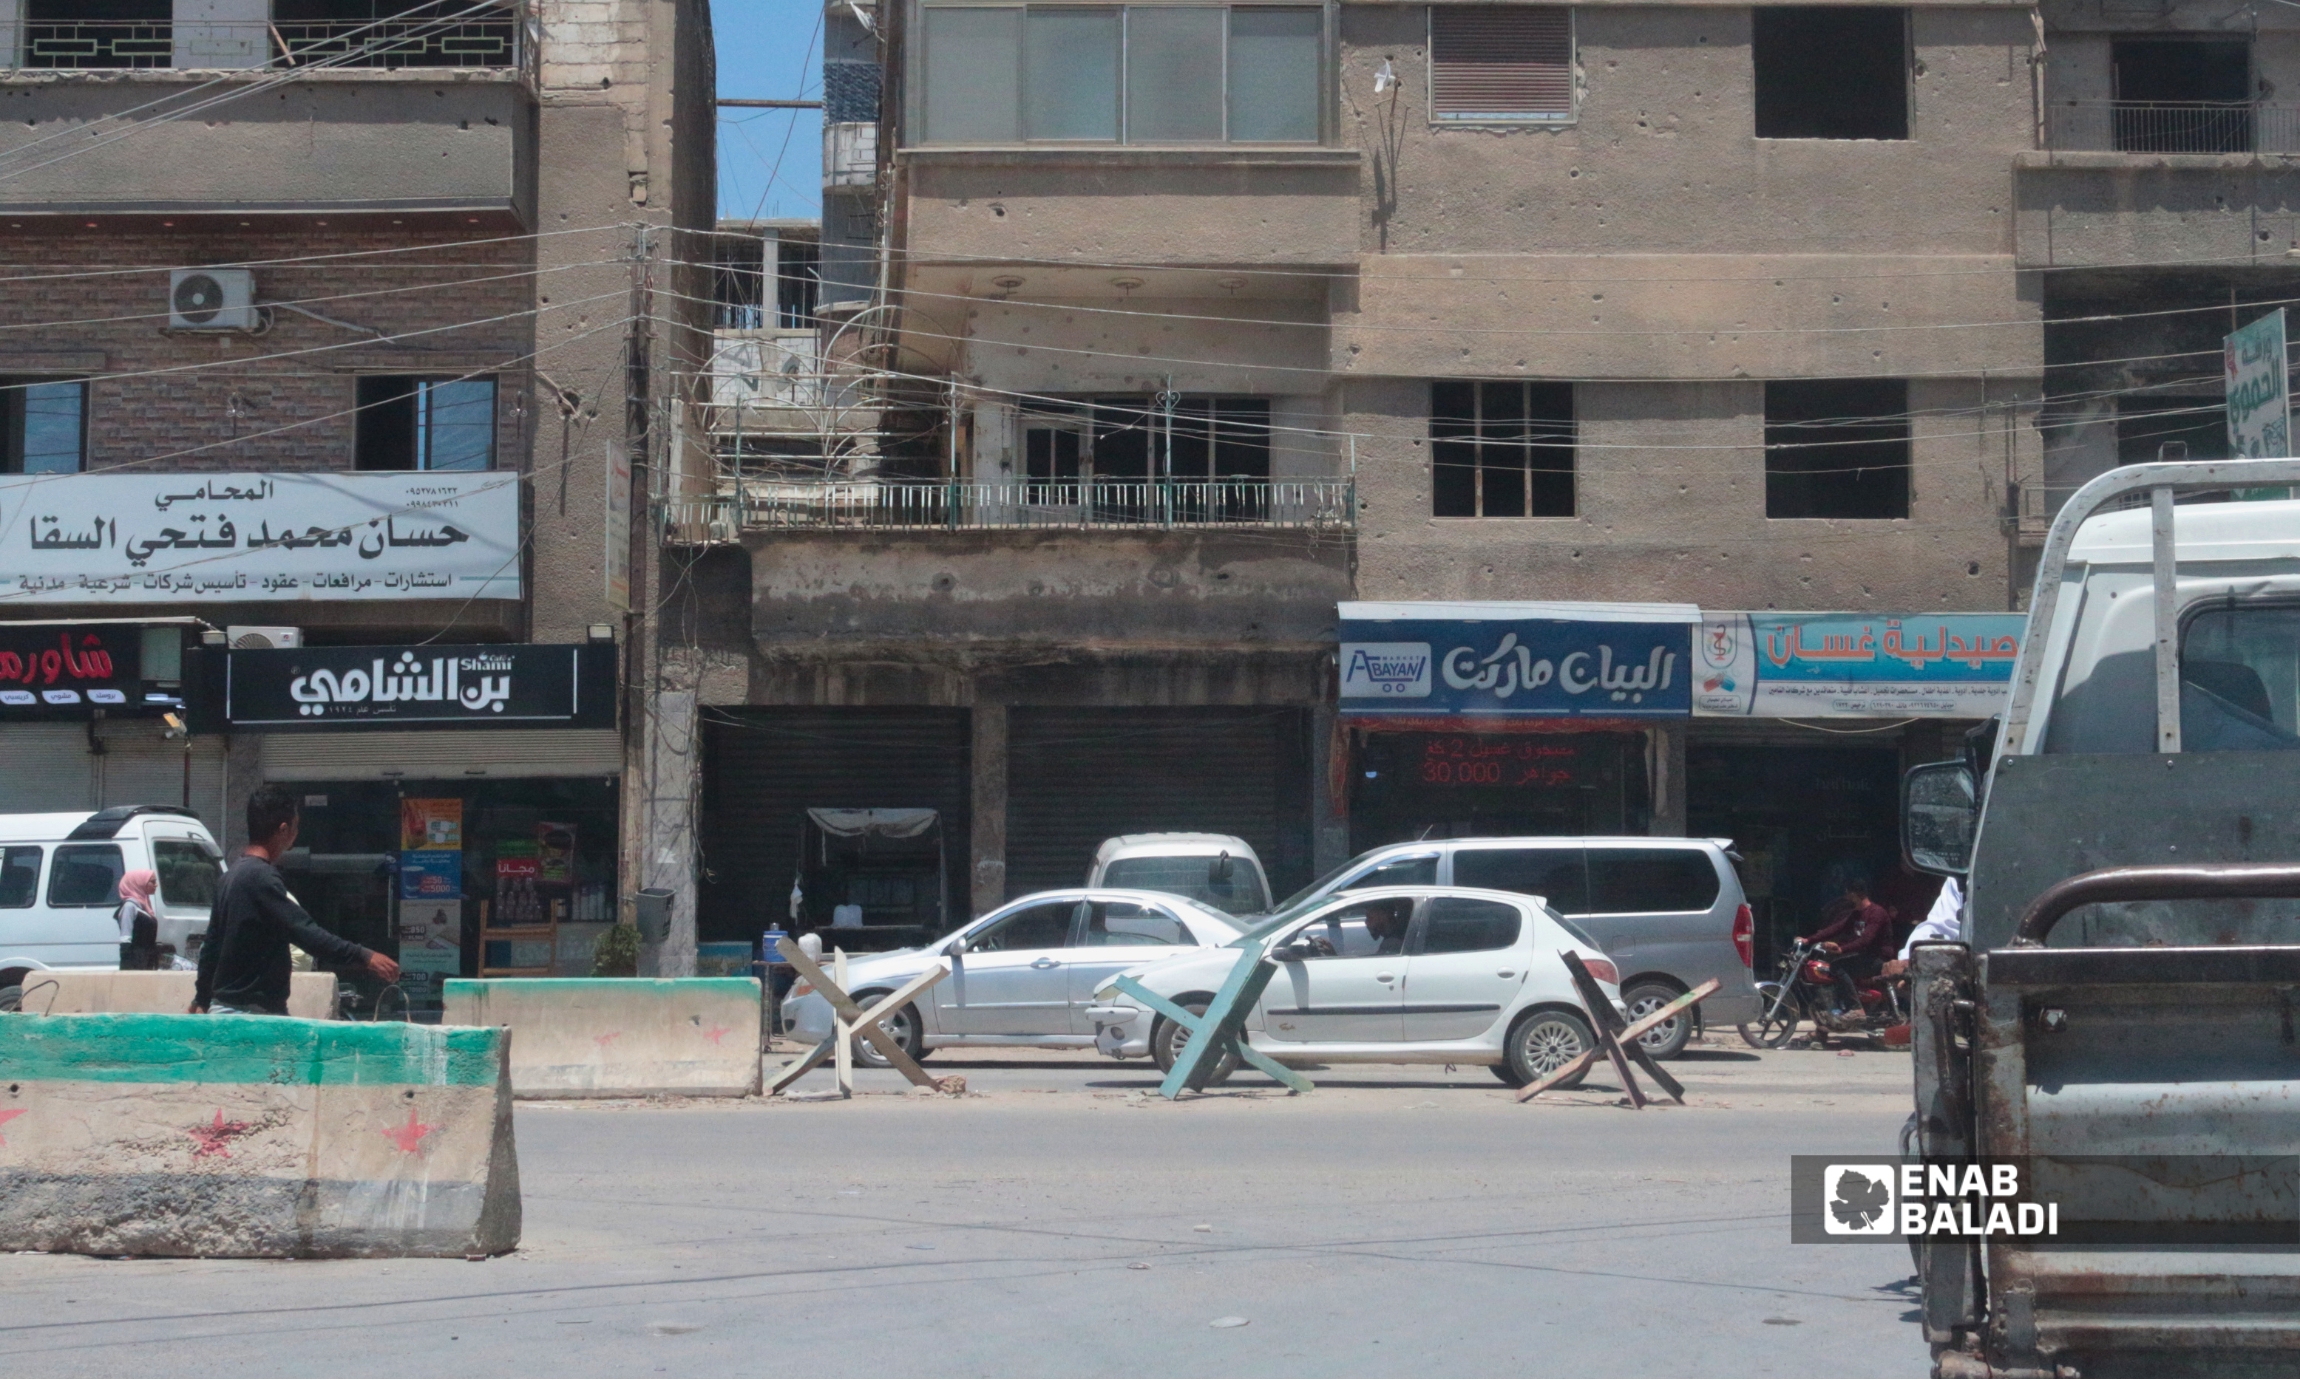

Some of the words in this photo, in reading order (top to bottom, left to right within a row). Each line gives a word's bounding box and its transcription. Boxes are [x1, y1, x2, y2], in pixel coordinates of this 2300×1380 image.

[2229, 356, 2281, 434] الحموي
[154, 478, 273, 512] المحامي
[30, 514, 116, 550] السقا
[125, 513, 236, 567] فتحي
[246, 518, 353, 551] محمد
[358, 513, 470, 560] حسان
[19, 574, 65, 594] مدنية
[78, 572, 131, 594] شرعية
[143, 572, 193, 594] شركات
[194, 570, 247, 594] تأسيس
[261, 572, 299, 593] عقود
[312, 571, 372, 592] مرافعات
[384, 571, 452, 591] استشارات
[1767, 624, 1875, 666] غسان
[1883, 619, 2018, 667] صيدلية
[0, 632, 113, 684] شاورم
[460, 656, 512, 671] Shami
[1441, 632, 1554, 698] ماركت
[290, 651, 459, 716] الشامي
[1559, 644, 1677, 703] البيان
[50, 692, 72, 702] مشوي
[459, 675, 510, 713] بن
[356, 704, 369, 716] عام
[1450, 738, 1464, 757] 2
[1469, 737, 1511, 758] غسيل
[1517, 740, 1575, 760] مسحوق
[1516, 766, 1572, 785] جواهر
[412, 972, 426, 981] 700
